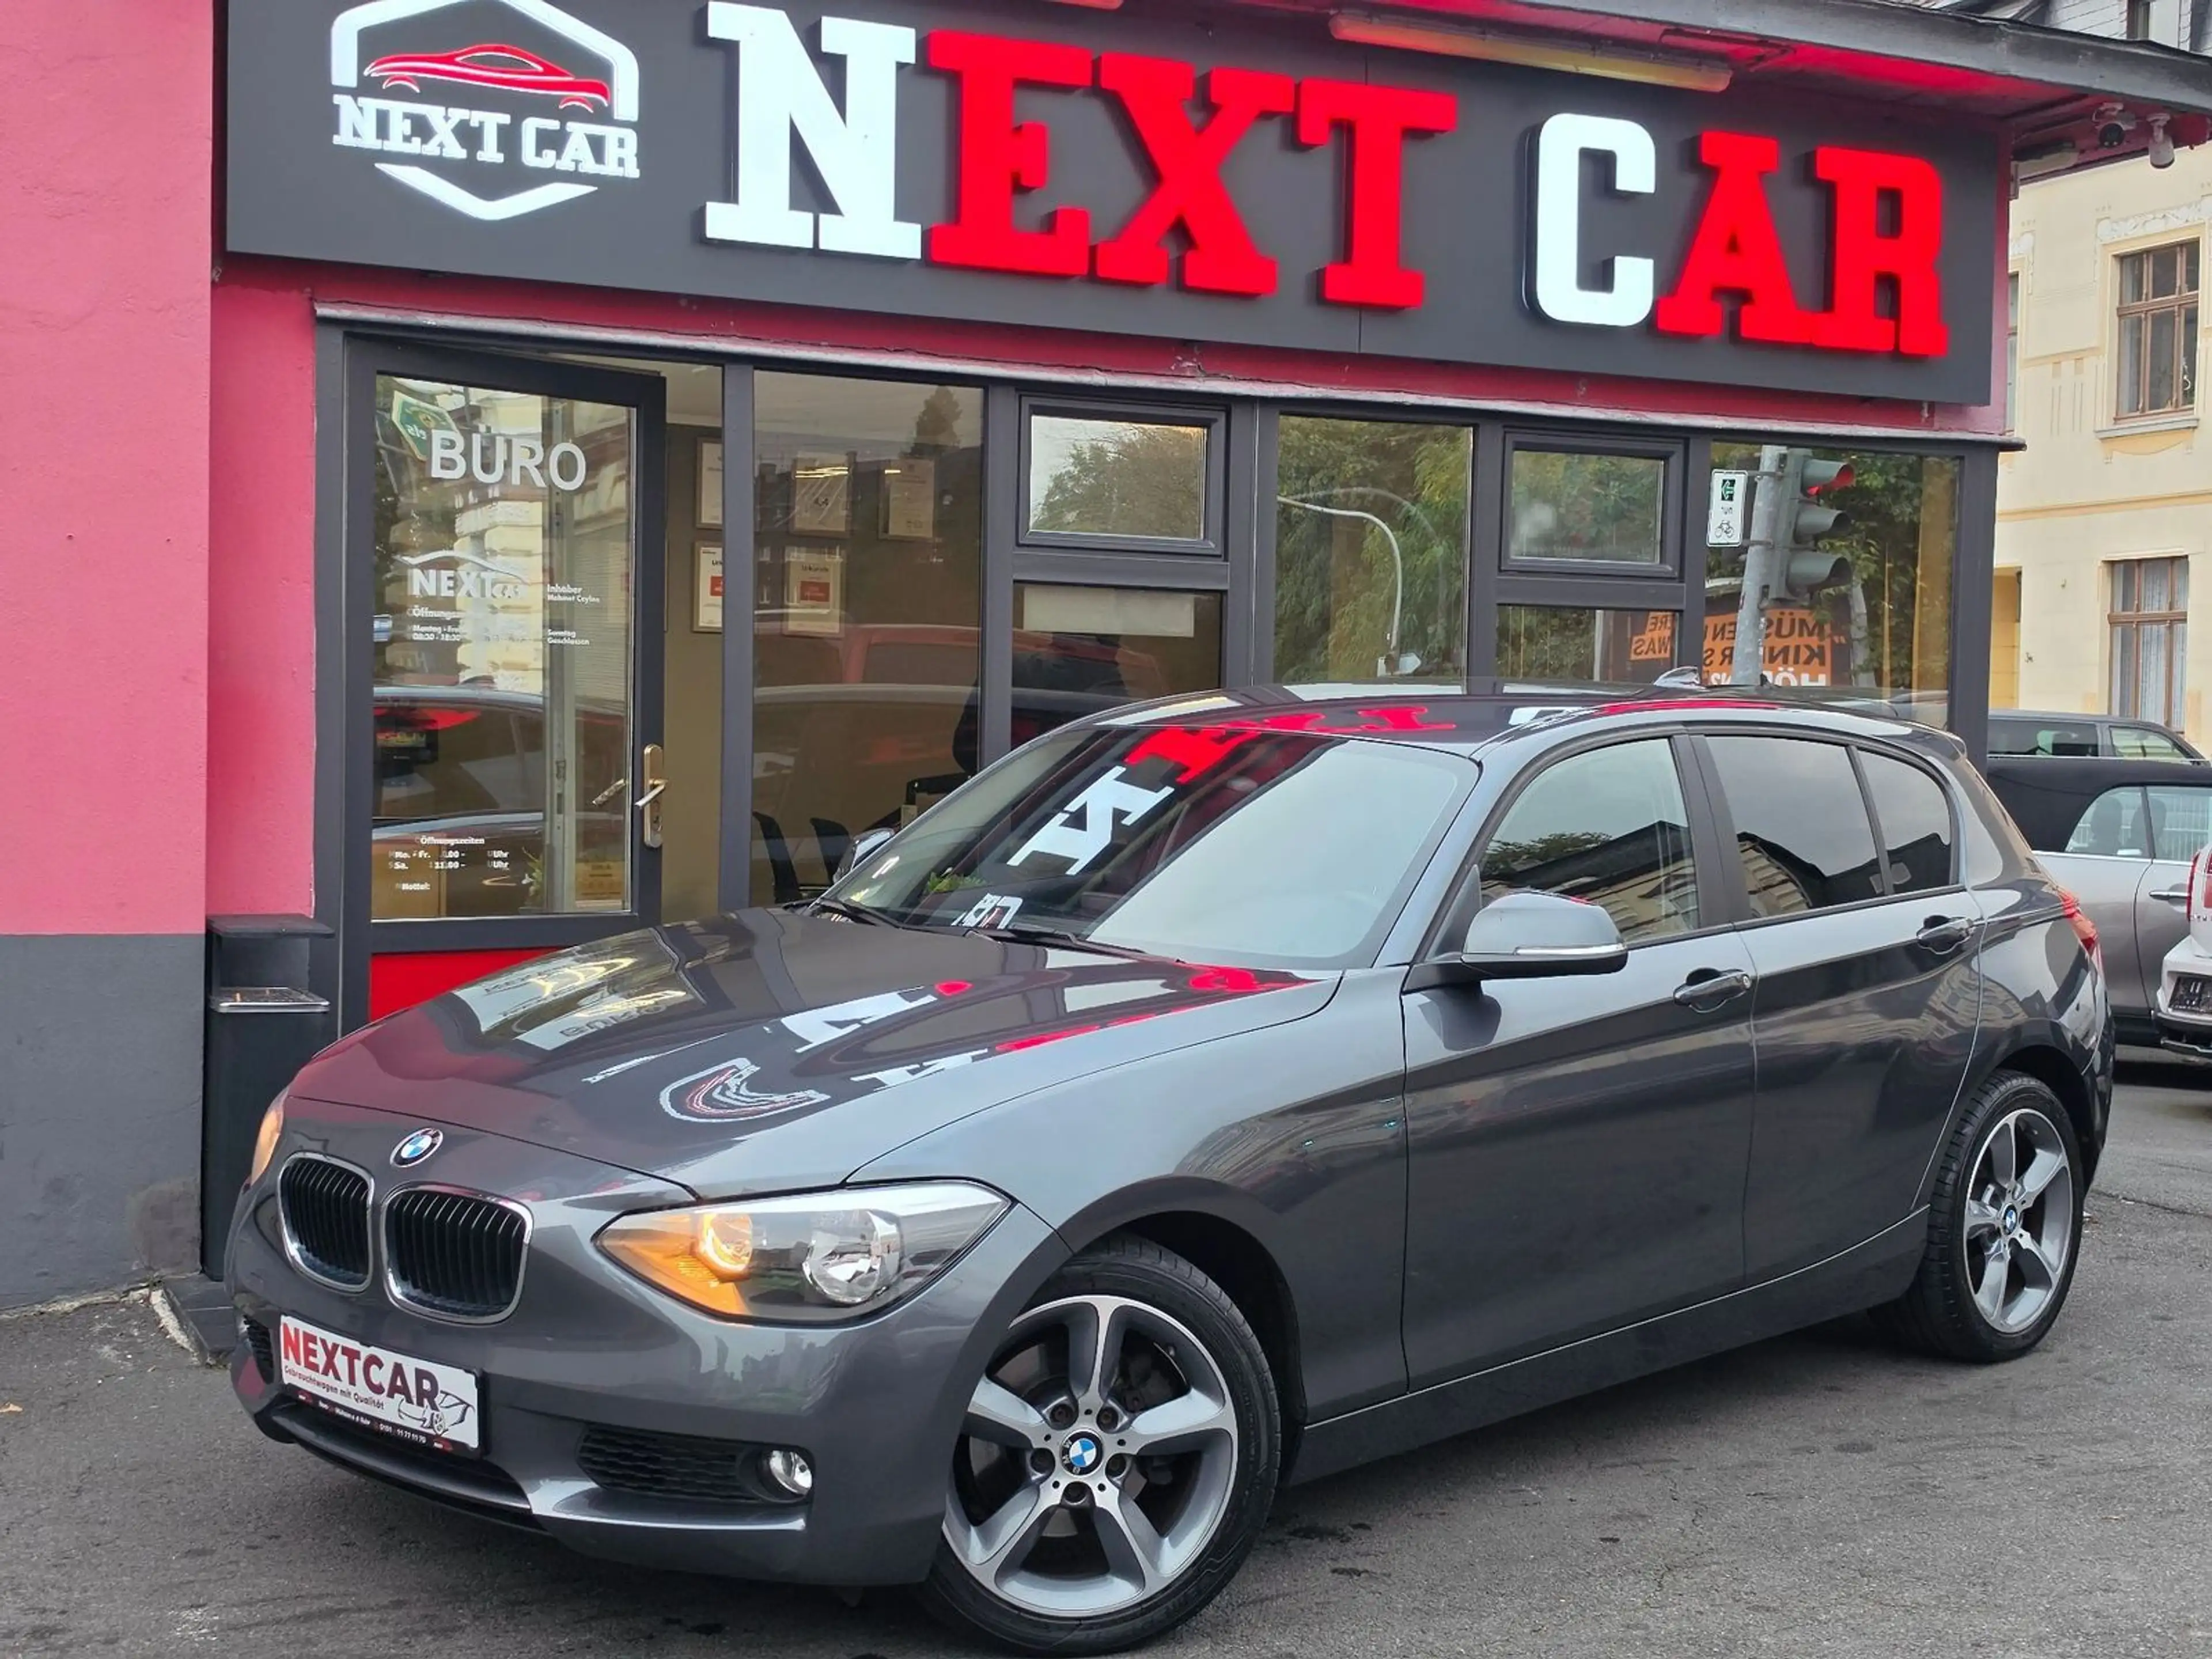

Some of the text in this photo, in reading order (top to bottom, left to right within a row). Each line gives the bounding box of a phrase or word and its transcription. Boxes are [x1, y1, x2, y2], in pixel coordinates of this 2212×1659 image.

[332, 94, 641, 178] NEXT CAR
[704, 1, 1949, 357] NEXT CAR
[420, 835, 485, 846] Öffnungszeiten
[282, 1323, 441, 1414] NEXTCAR
[285, 1365, 384, 1410] Gebrauchtwagen mit Qualität
